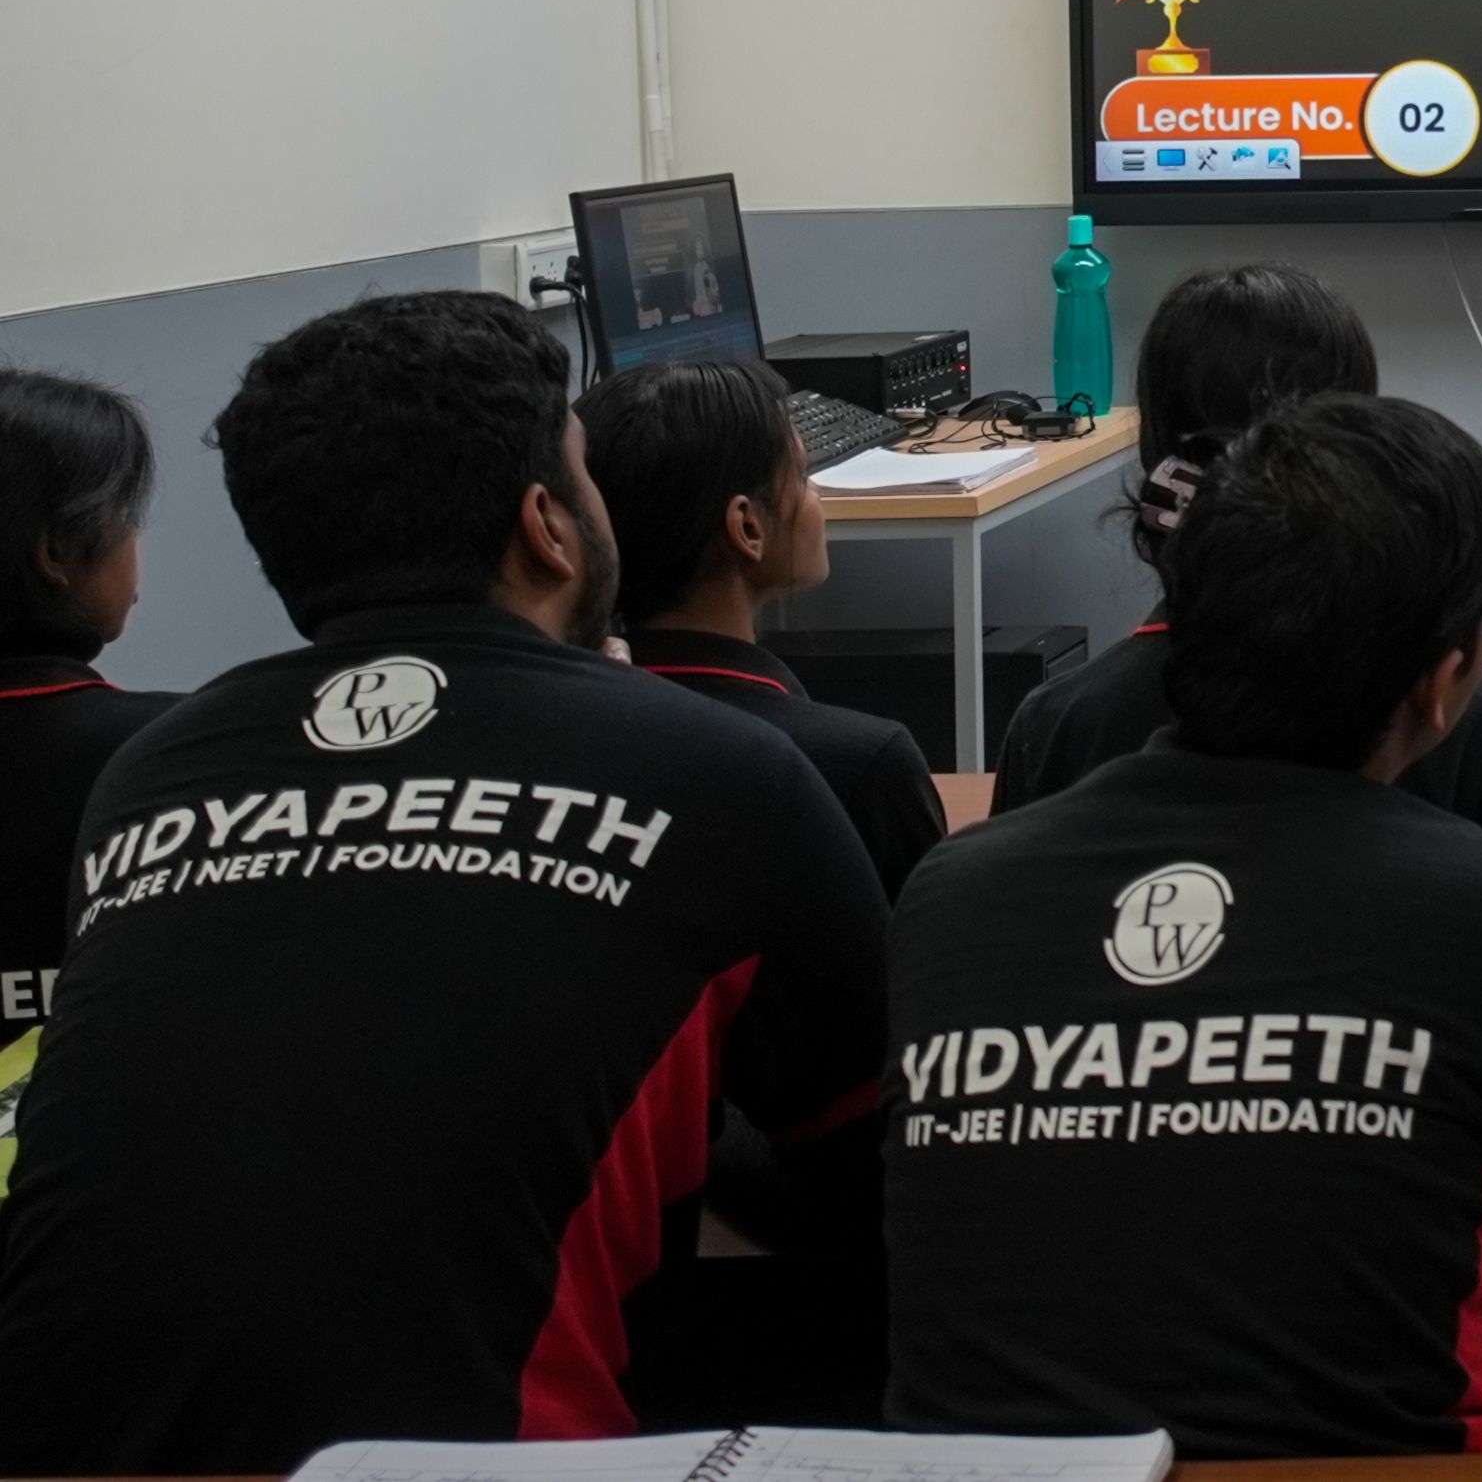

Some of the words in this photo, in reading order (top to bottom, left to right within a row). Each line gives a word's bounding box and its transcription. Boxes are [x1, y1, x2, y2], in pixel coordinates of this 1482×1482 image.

[1138, 103, 1280, 132] Lecture
[1292, 102, 1352, 130] No.
[1400, 103, 1444, 132] 02
[85, 779, 671, 896] VIDYAPEETH
[194, 849, 300, 886] NEET
[328, 843, 632, 907] FOUNDATION
[903, 1015, 1430, 1103] VIDYAPEETH
[906, 1109, 1005, 1147] IIT-JEE
[1029, 1106, 1122, 1140] NEET
[1148, 1099, 1413, 1140] FOUNDATION
